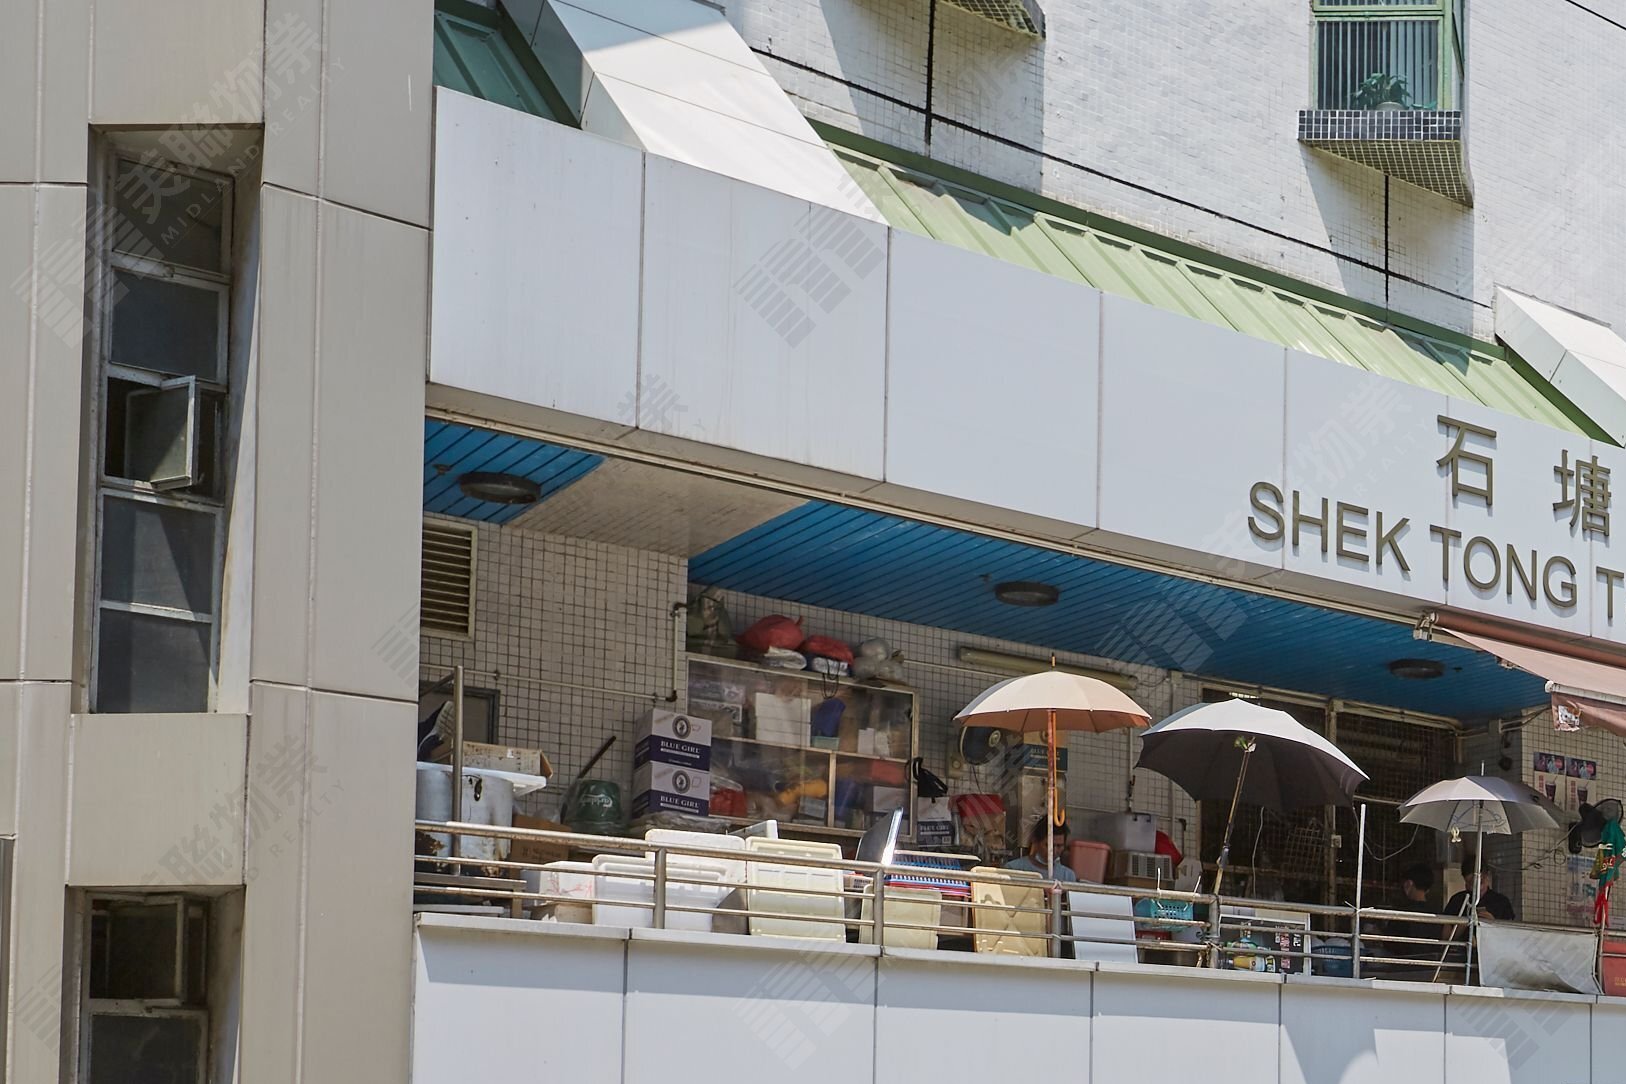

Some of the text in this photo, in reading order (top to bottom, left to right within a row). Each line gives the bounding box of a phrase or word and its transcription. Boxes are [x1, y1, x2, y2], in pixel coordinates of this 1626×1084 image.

[1247, 481, 1411, 573] SHEK
[1429, 524, 1578, 609] TONG
[660, 740, 700, 753] BLUE GIRL
[660, 795, 700, 808] BLUE GIRL
